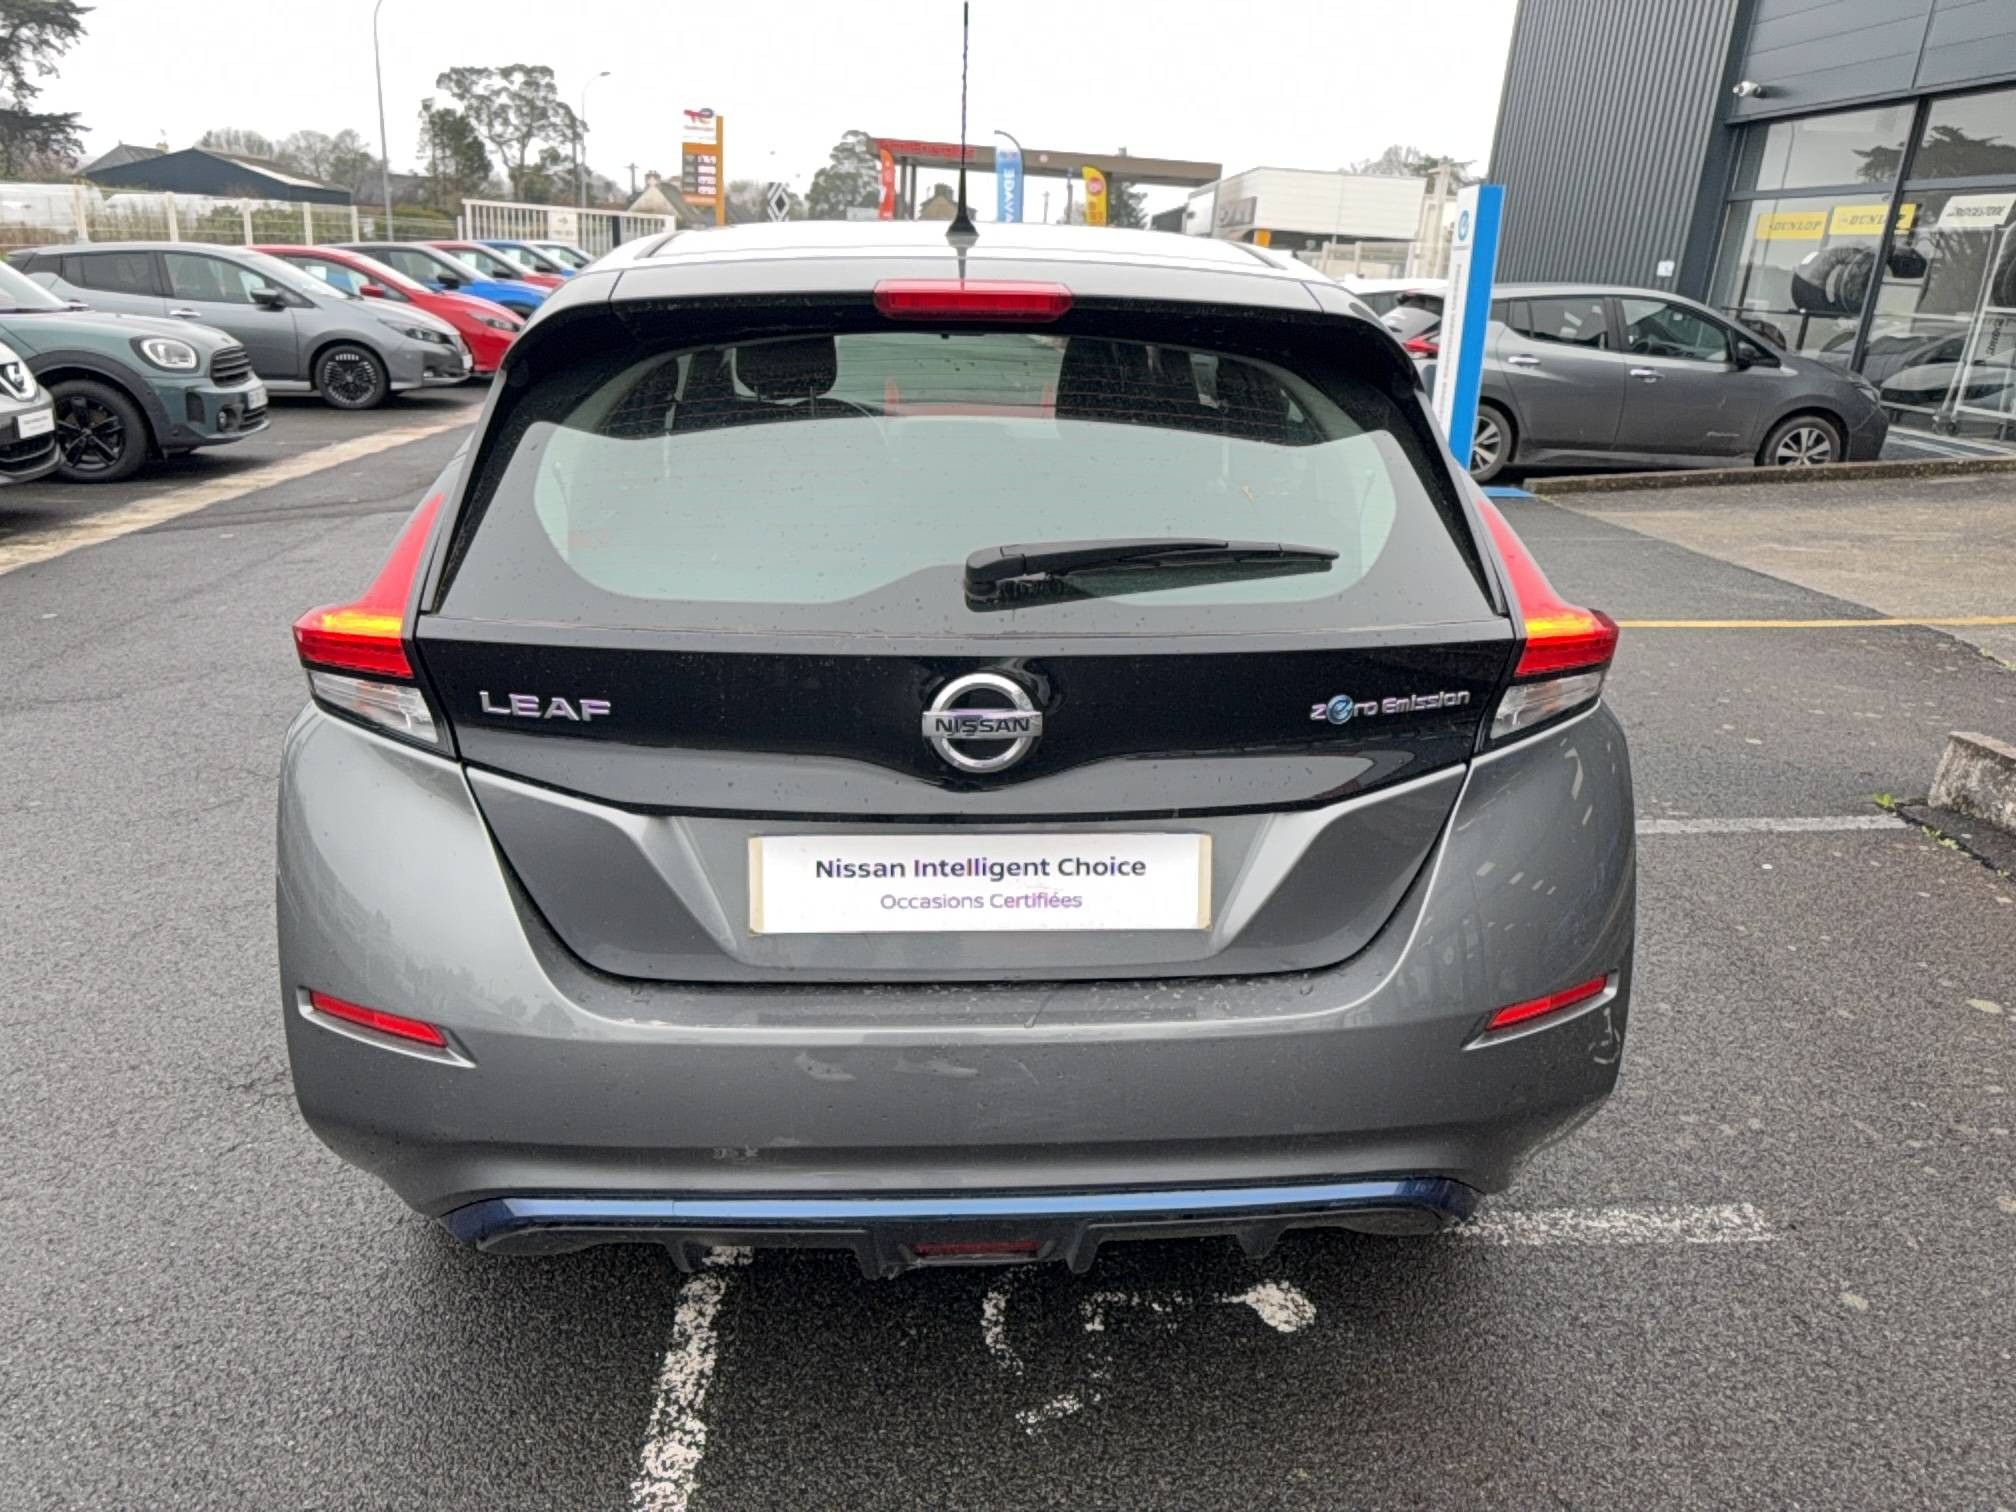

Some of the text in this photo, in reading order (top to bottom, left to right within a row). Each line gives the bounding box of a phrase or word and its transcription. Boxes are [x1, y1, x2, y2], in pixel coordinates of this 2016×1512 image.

[1847, 213, 1906, 226] DUNLP
[479, 690, 611, 722] LEAF
[1382, 690, 1471, 715] Emission
[935, 717, 1031, 734] NISSAN
[815, 856, 1147, 882] Nissan Intelligent Choice
[880, 891, 1083, 910] Occasions Certifiées
